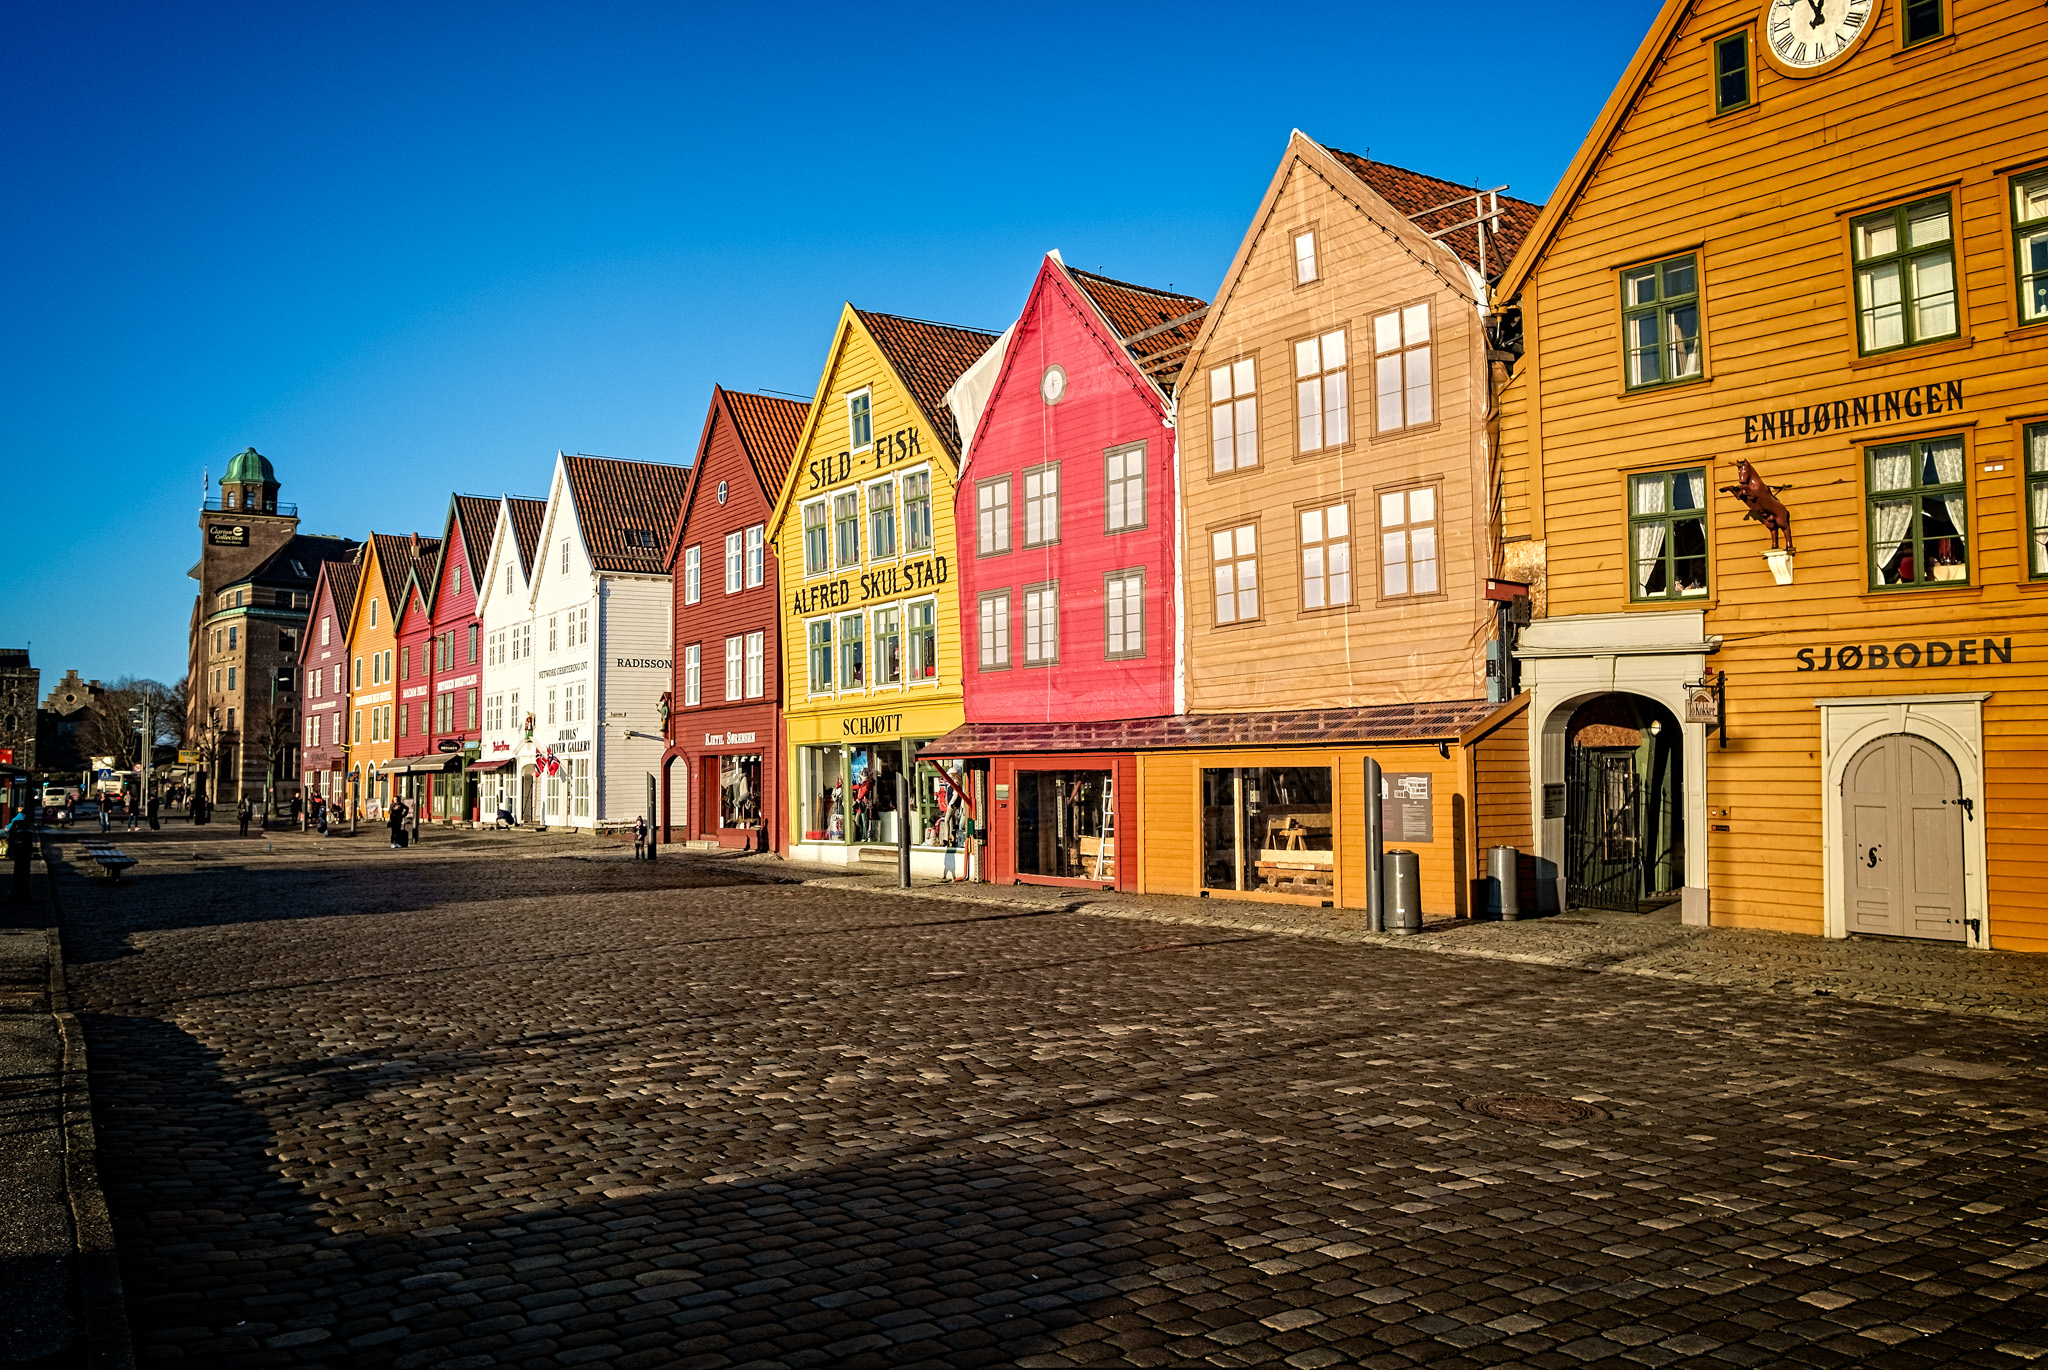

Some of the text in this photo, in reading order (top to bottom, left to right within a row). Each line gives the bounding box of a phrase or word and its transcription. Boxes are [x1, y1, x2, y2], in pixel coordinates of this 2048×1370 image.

[1745, 380, 1964, 443] ENHJØRNINGEN
[809, 451, 851, 490] SILD
[875, 427, 922, 469] FISK
[793, 556, 948, 615] ALFRED SKULSTAD
[617, 658, 673, 669] RADISSON
[1796, 637, 2013, 672] SJØBODEN
[843, 714, 902, 736] SCHJØTT
[567, 740, 592, 753] GALLERY
